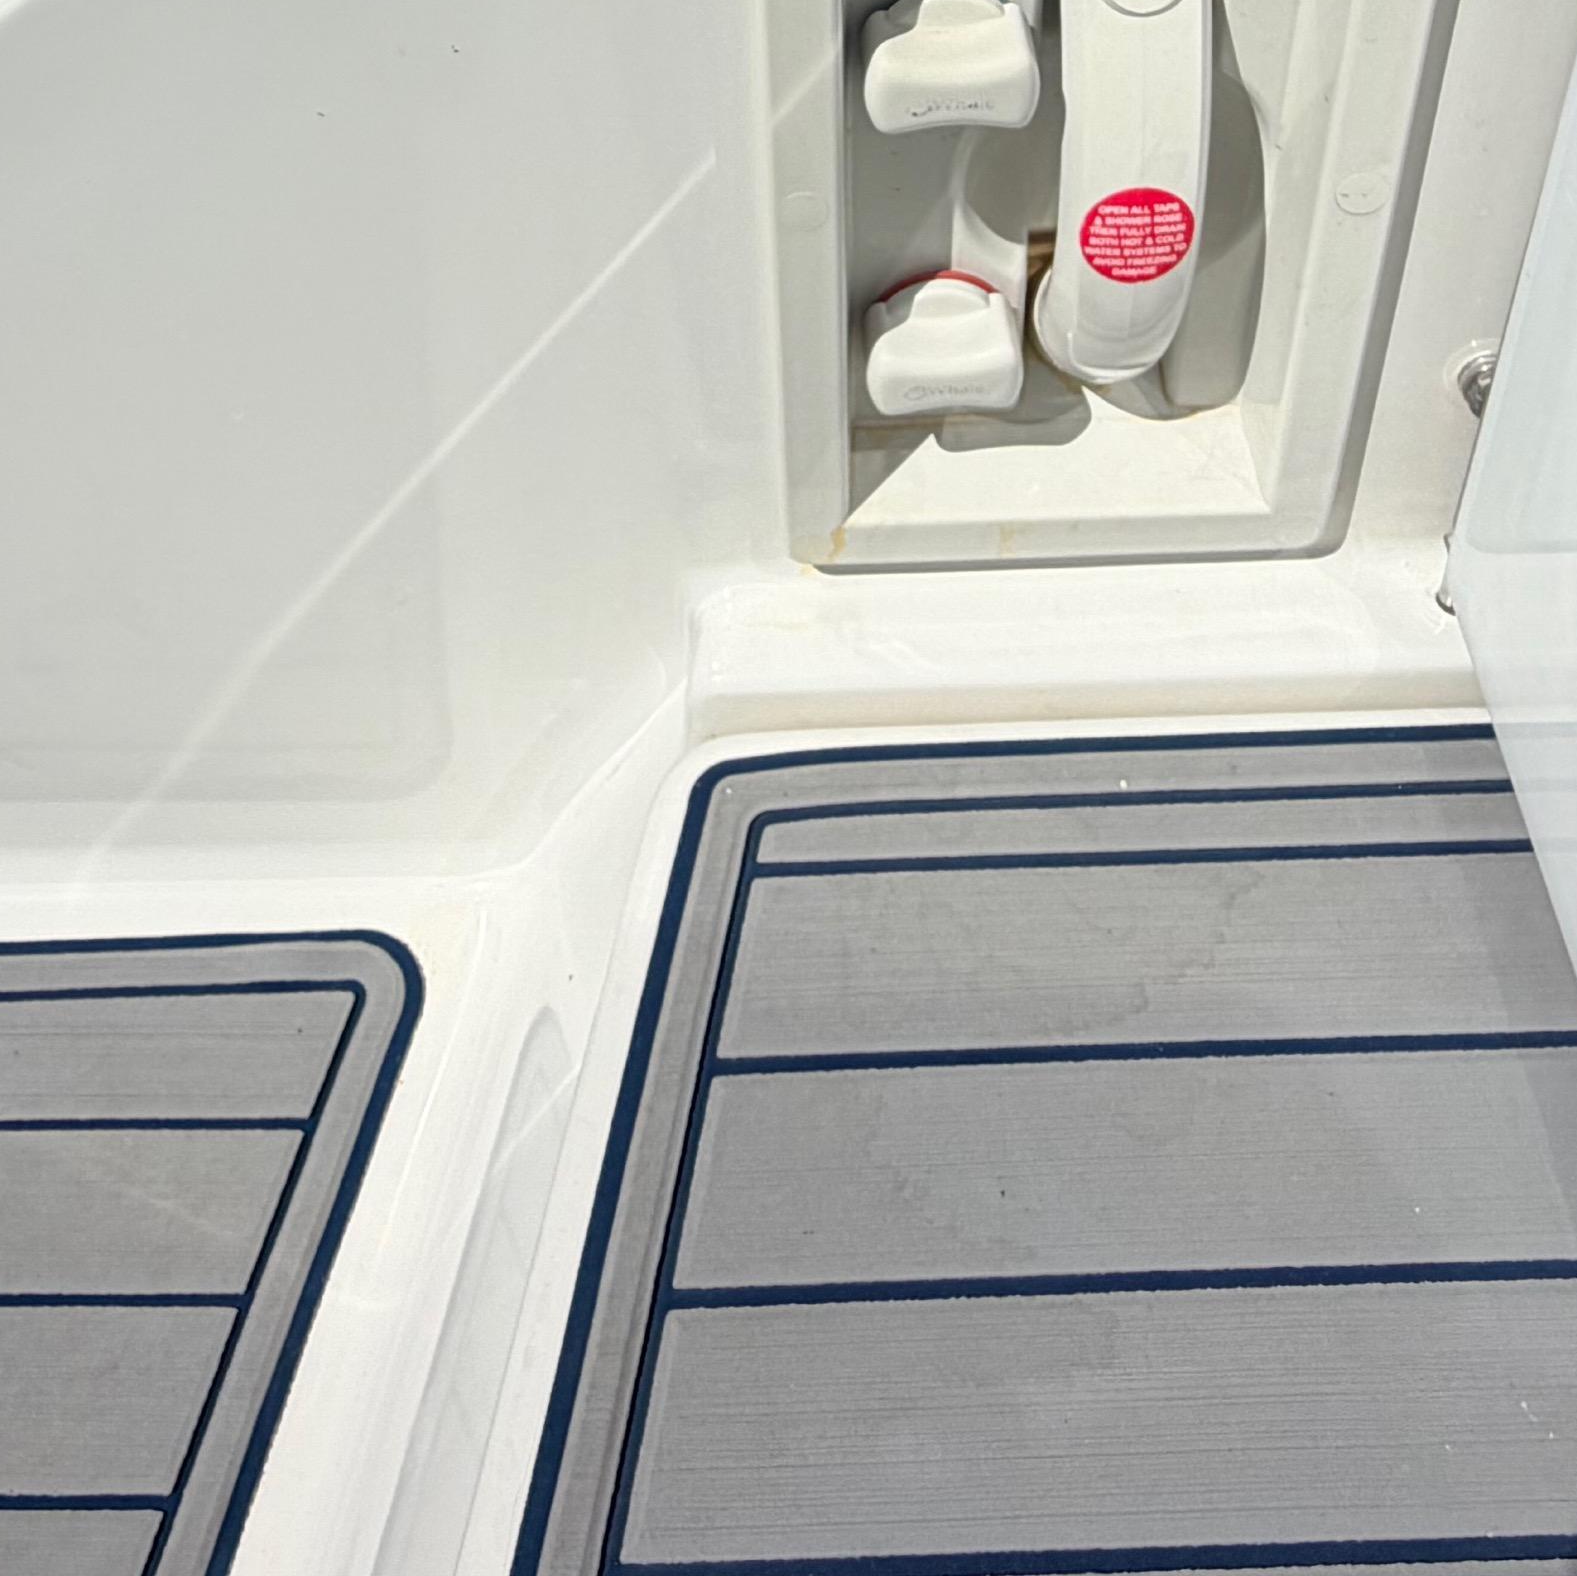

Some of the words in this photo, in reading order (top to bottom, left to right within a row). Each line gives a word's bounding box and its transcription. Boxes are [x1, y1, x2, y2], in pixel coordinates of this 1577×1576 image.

[1130, 205, 1150, 214] ALL
[1120, 227, 1152, 236] FULLY
[1089, 237, 1118, 246] BOTH
[1121, 237, 1143, 246] HOT
[1084, 246, 1120, 256] WATER
